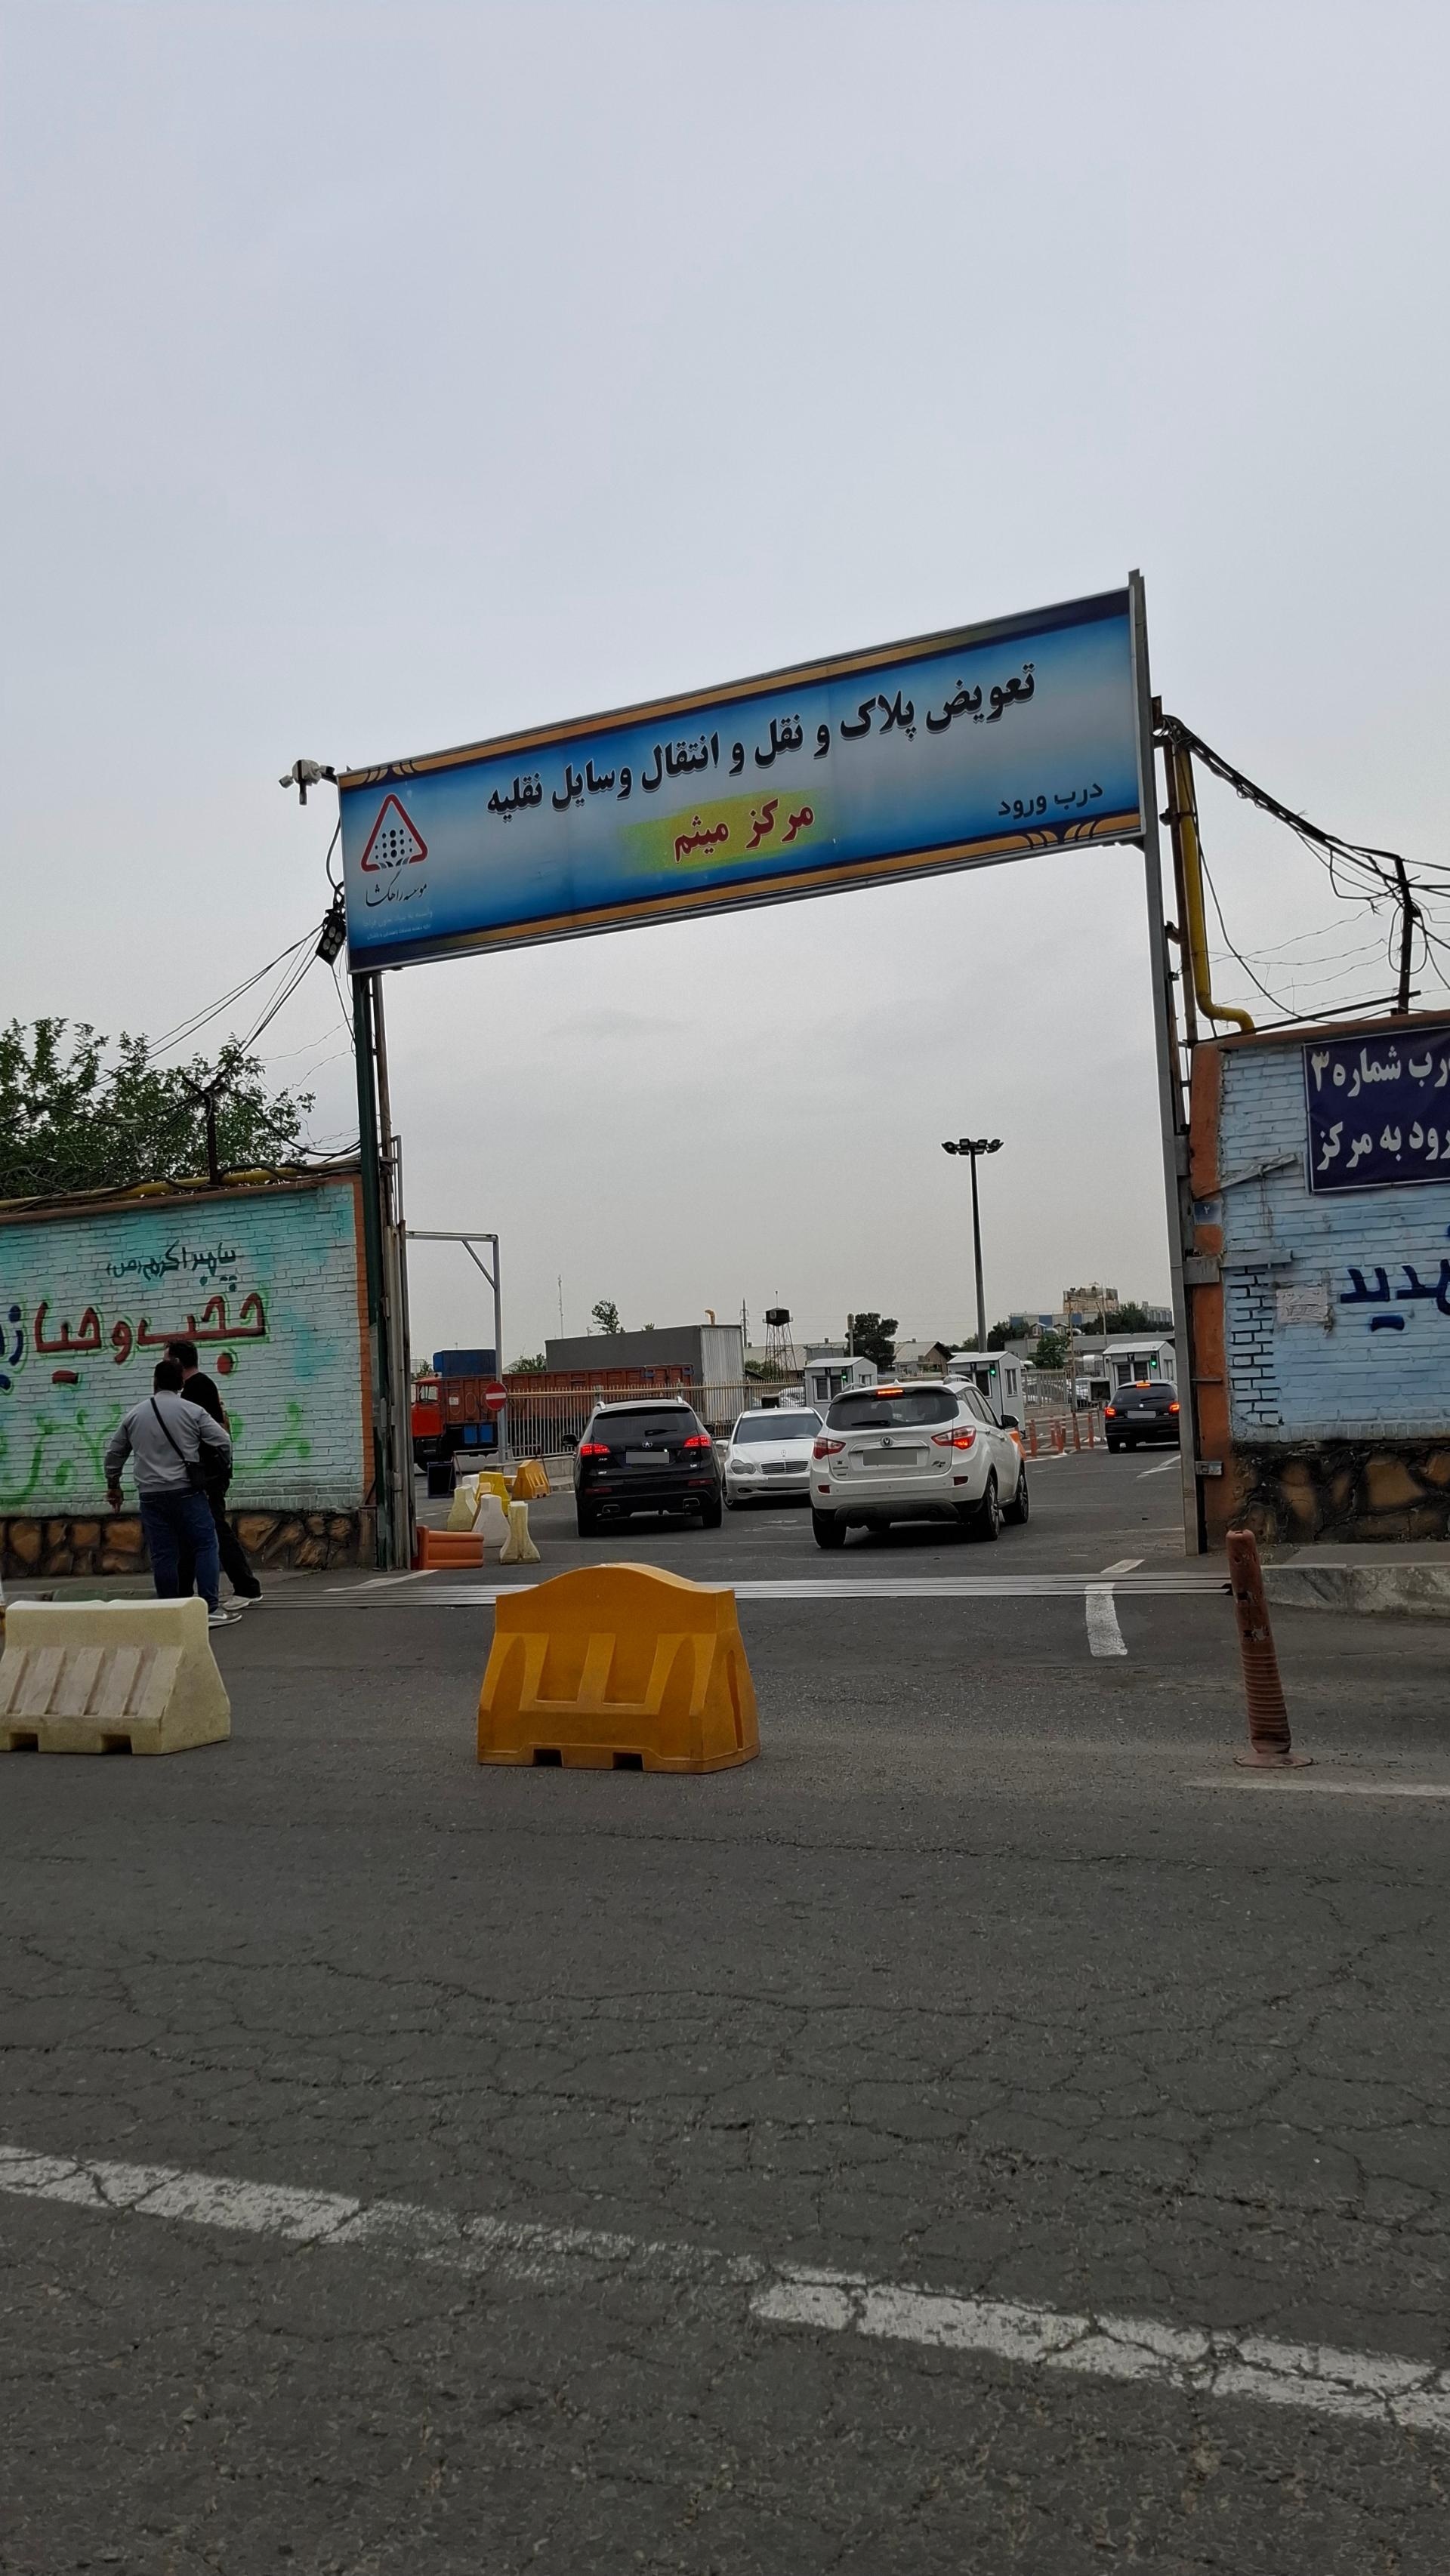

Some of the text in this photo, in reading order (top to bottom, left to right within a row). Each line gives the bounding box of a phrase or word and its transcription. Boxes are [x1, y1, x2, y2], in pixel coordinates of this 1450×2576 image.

[487, 663, 1035, 822] تعویض پلاک و نقل و انتقال وسایل نقلیه
[998, 783, 1103, 819] درب ورود
[674, 798, 814, 863] مرکز میثم
[1408, 1052, 1450, 1087] رب
[1317, 1121, 1450, 1170] رود به مرکز
